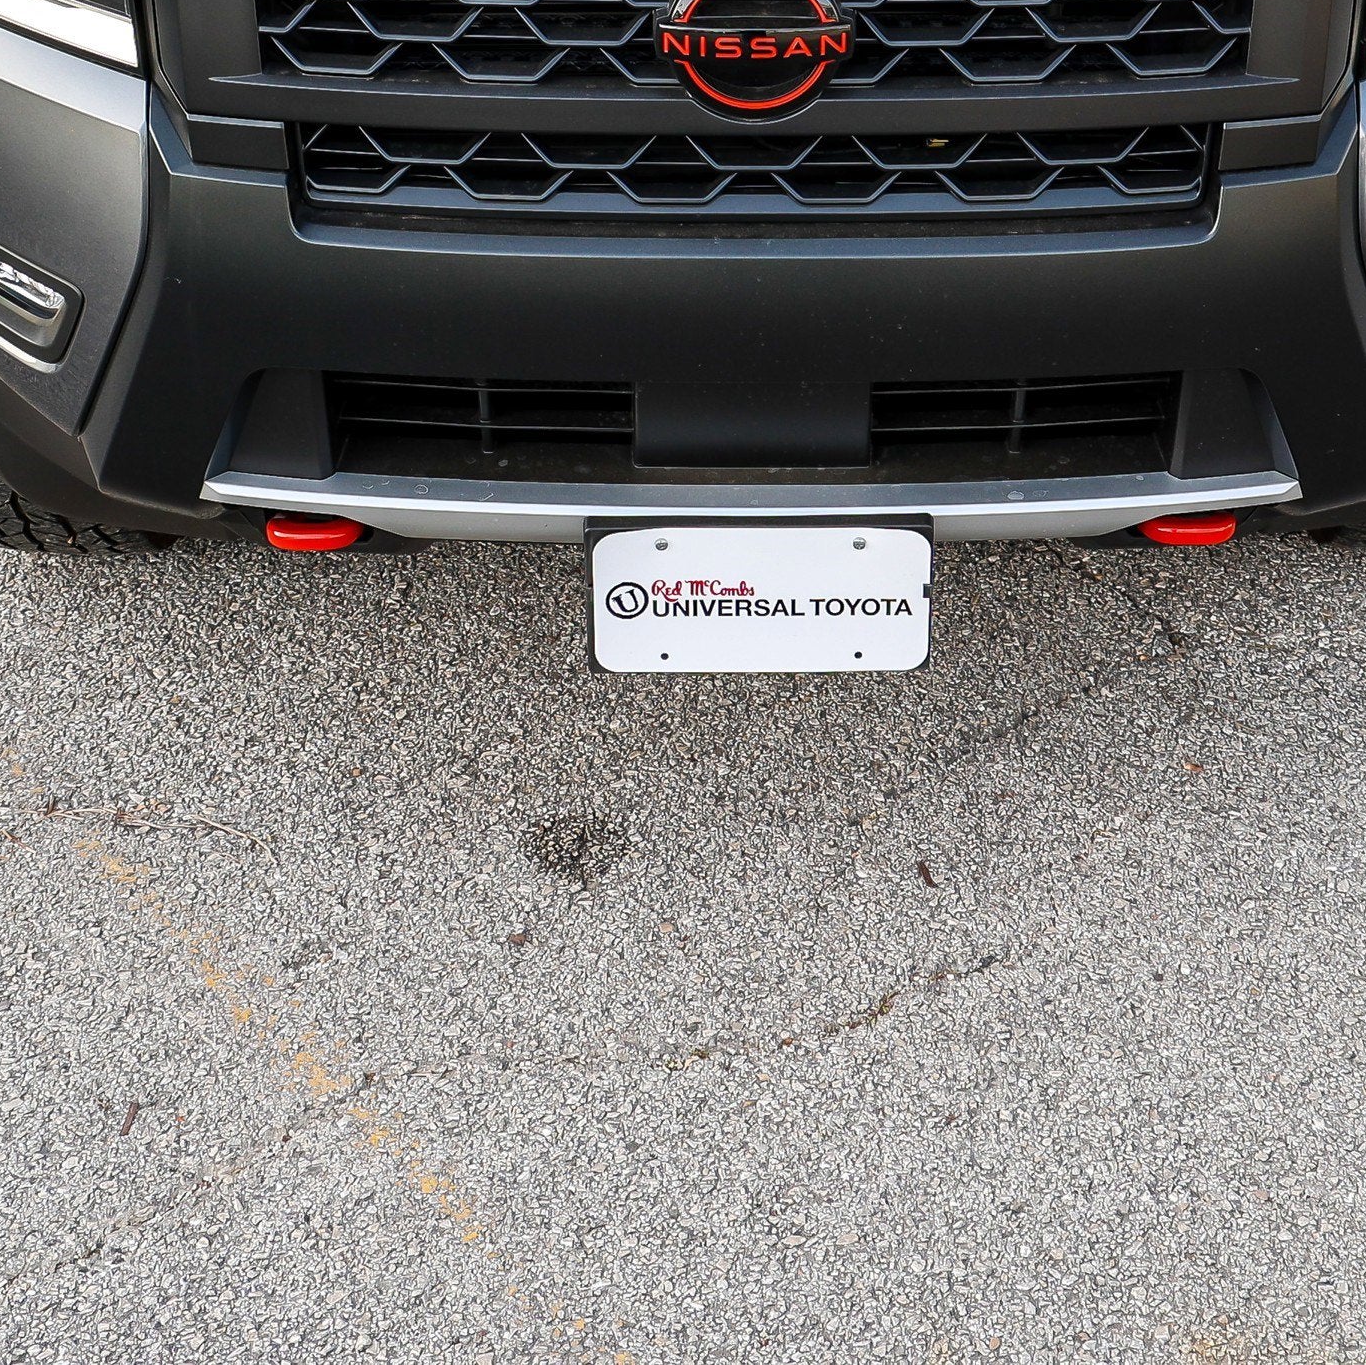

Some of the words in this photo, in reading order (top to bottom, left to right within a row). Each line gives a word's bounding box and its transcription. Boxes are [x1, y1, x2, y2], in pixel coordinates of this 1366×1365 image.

[661, 31, 848, 60] NISSAN
[651, 579, 683, 602] Red
[652, 598, 806, 618] UNIVERSAL
[809, 598, 914, 617] TOYOTA
